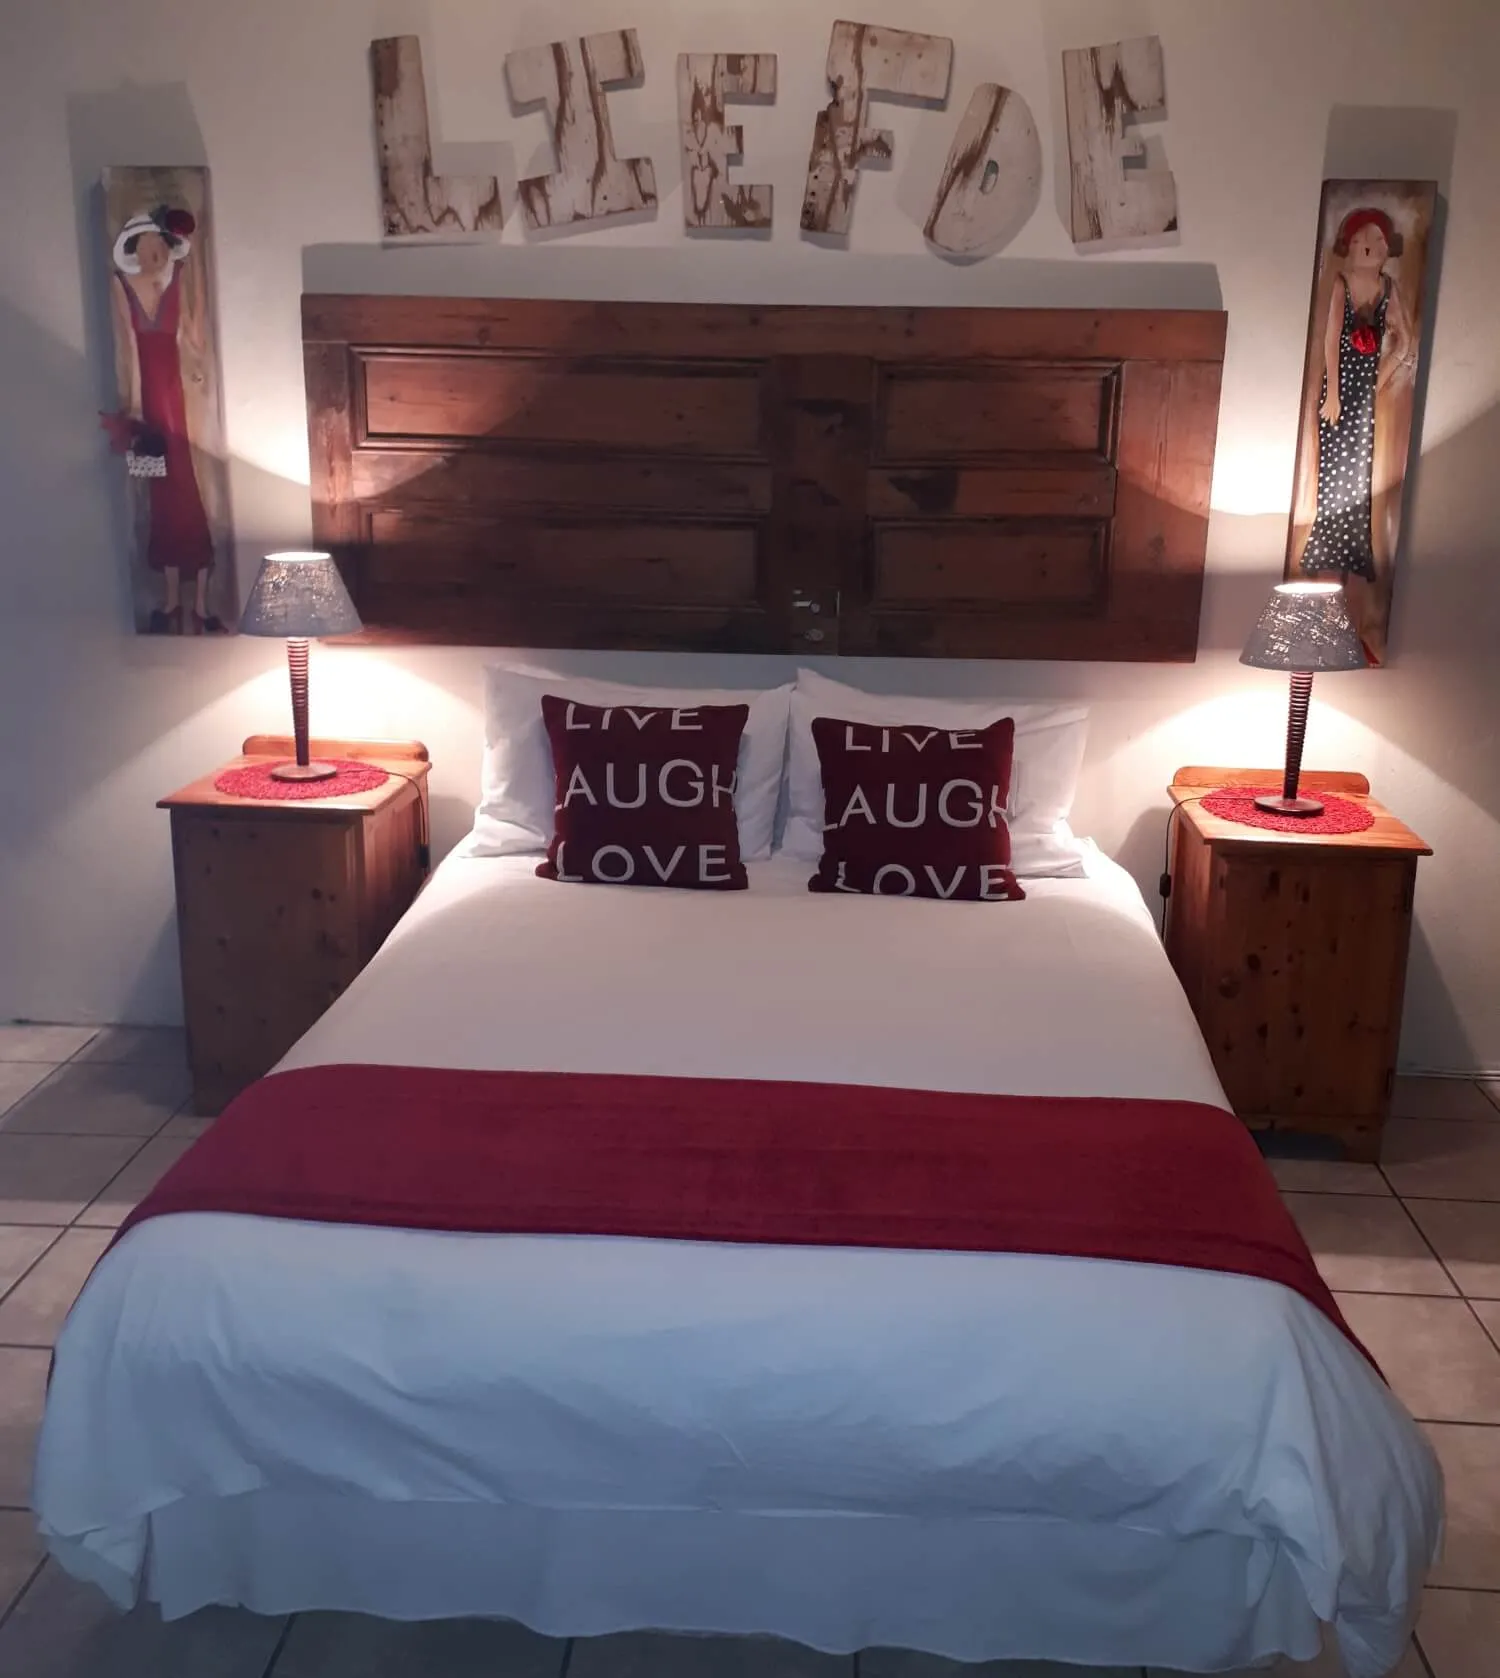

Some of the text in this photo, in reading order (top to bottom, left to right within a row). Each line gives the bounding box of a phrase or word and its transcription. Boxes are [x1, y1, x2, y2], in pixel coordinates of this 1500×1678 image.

[370, 19, 1180, 258] LIEFDE
[565, 702, 703, 730] LIVE
[845, 725, 983, 752] LIVE
[555, 759, 737, 811] AUGH
[556, 841, 731, 882] LOVE
[834, 861, 1009, 900] LOVE
